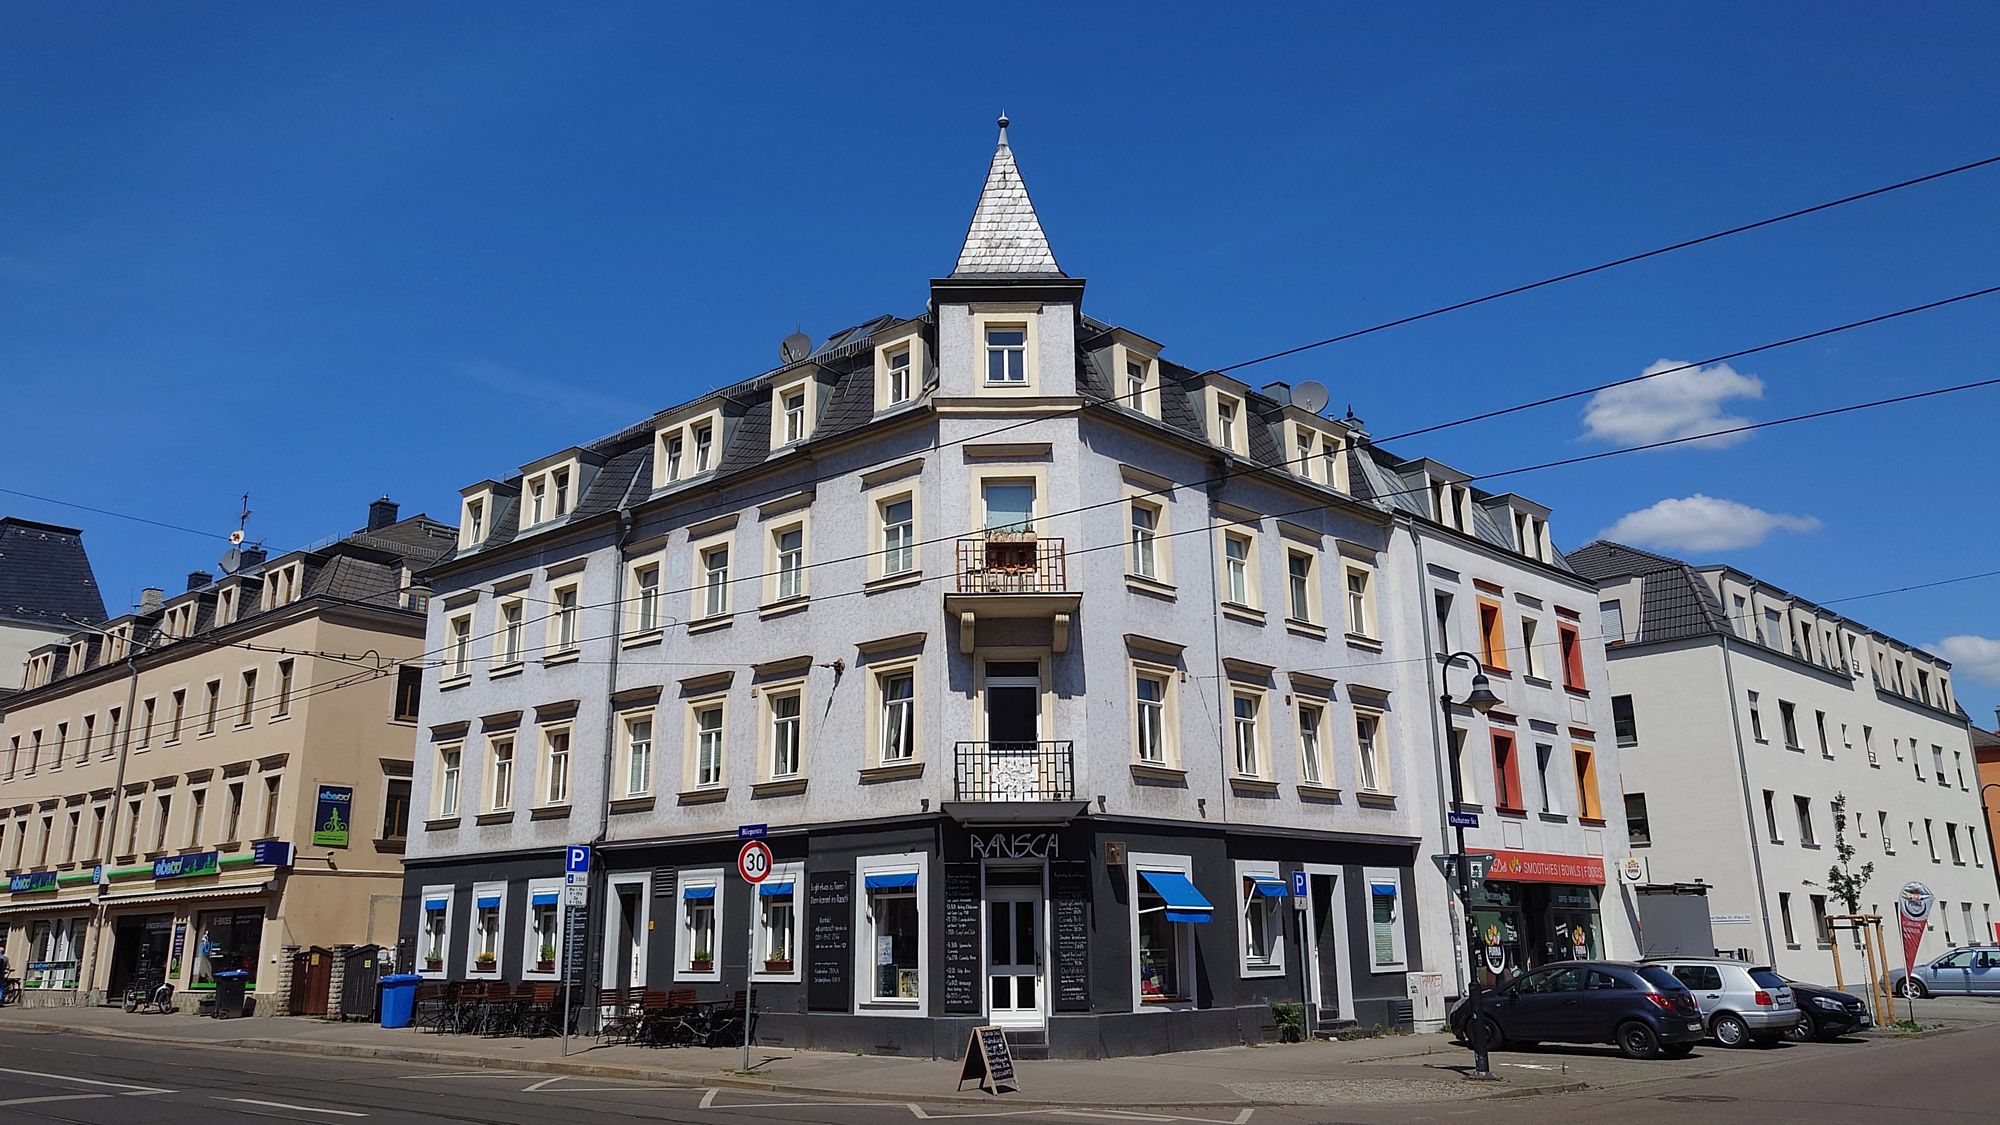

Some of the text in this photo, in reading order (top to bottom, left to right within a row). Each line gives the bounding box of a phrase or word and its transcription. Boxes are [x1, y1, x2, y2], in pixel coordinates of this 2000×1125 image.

[571, 849, 585, 869] P
[746, 853, 765, 871] 30
[1523, 861, 1558, 875] SMOOTHIES
[1561, 865, 1581, 877] BOWLS
[1583, 866, 1603, 878] FOODS
[1295, 874, 1304, 893] P
